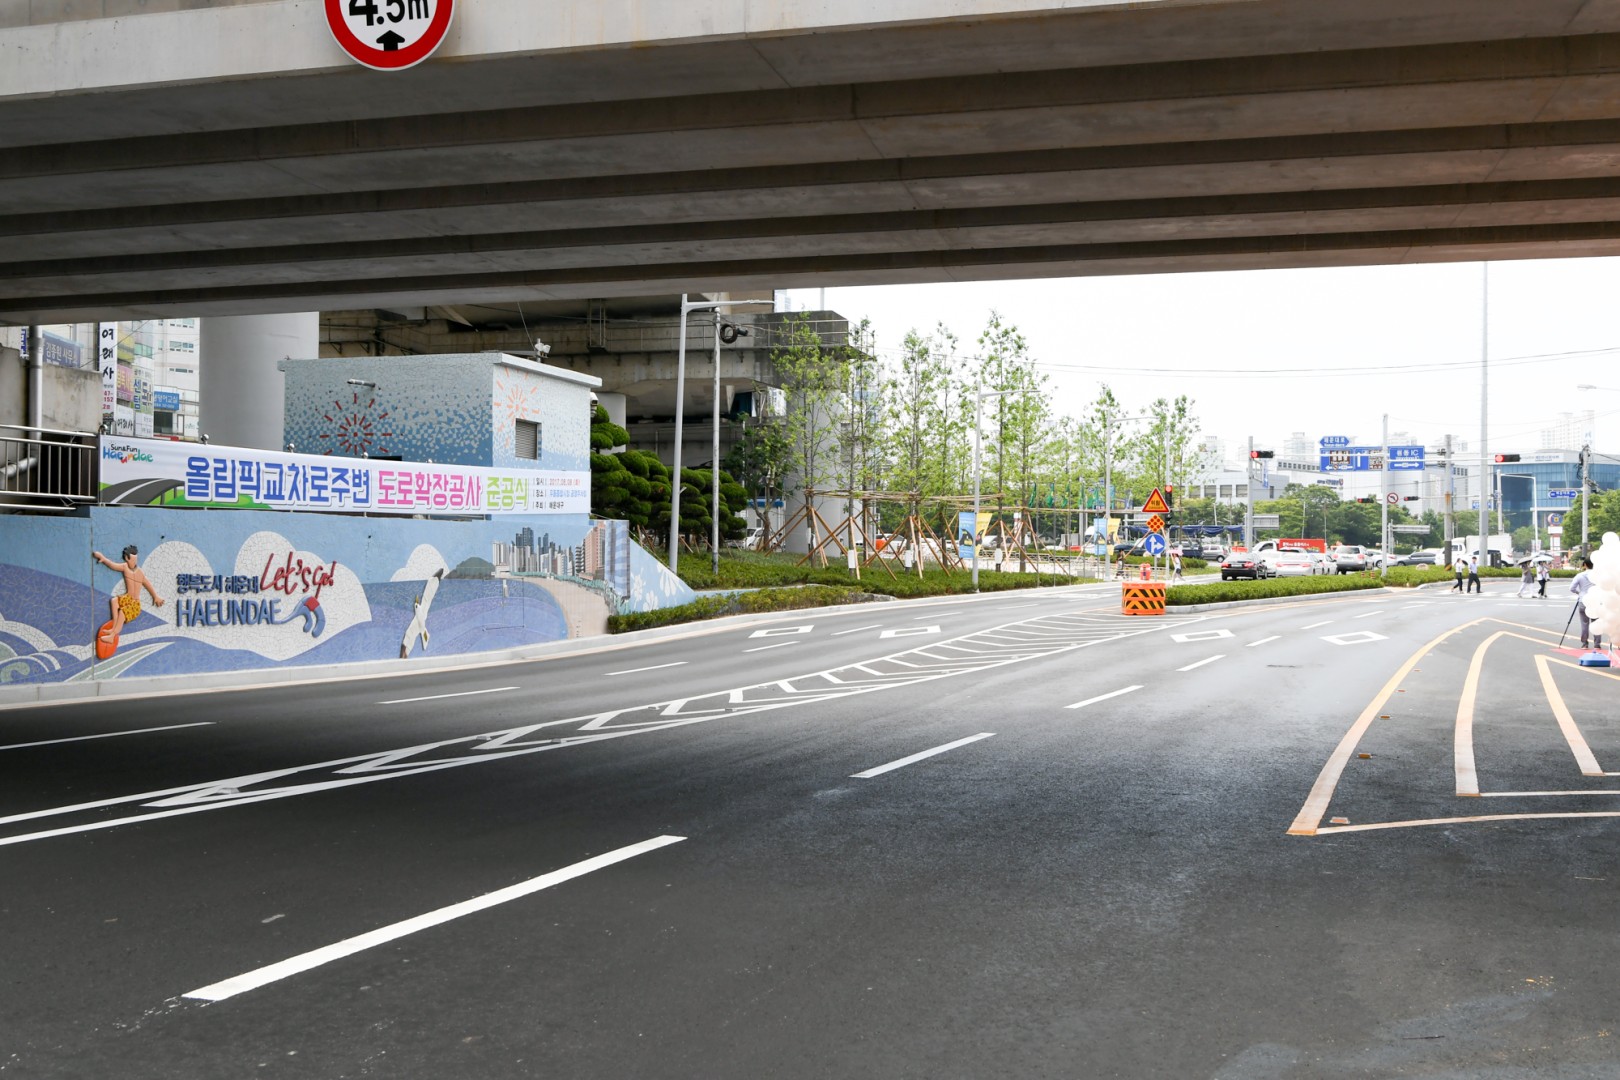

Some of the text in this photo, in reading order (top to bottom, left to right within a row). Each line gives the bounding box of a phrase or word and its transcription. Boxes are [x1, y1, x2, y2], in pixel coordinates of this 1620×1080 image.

[349, 0, 429, 26] 4.5m
[46, 342, 62, 361] 김종원
[110, 443, 138, 452] Sun&Fun
[186, 456, 528, 508] 올림픽교차로주변 도로확장공사 준공식
[176, 573, 259, 594] 행복도시 해운대
[260, 551, 310, 595] Let's
[176, 598, 283, 627] HAEUNDAE
